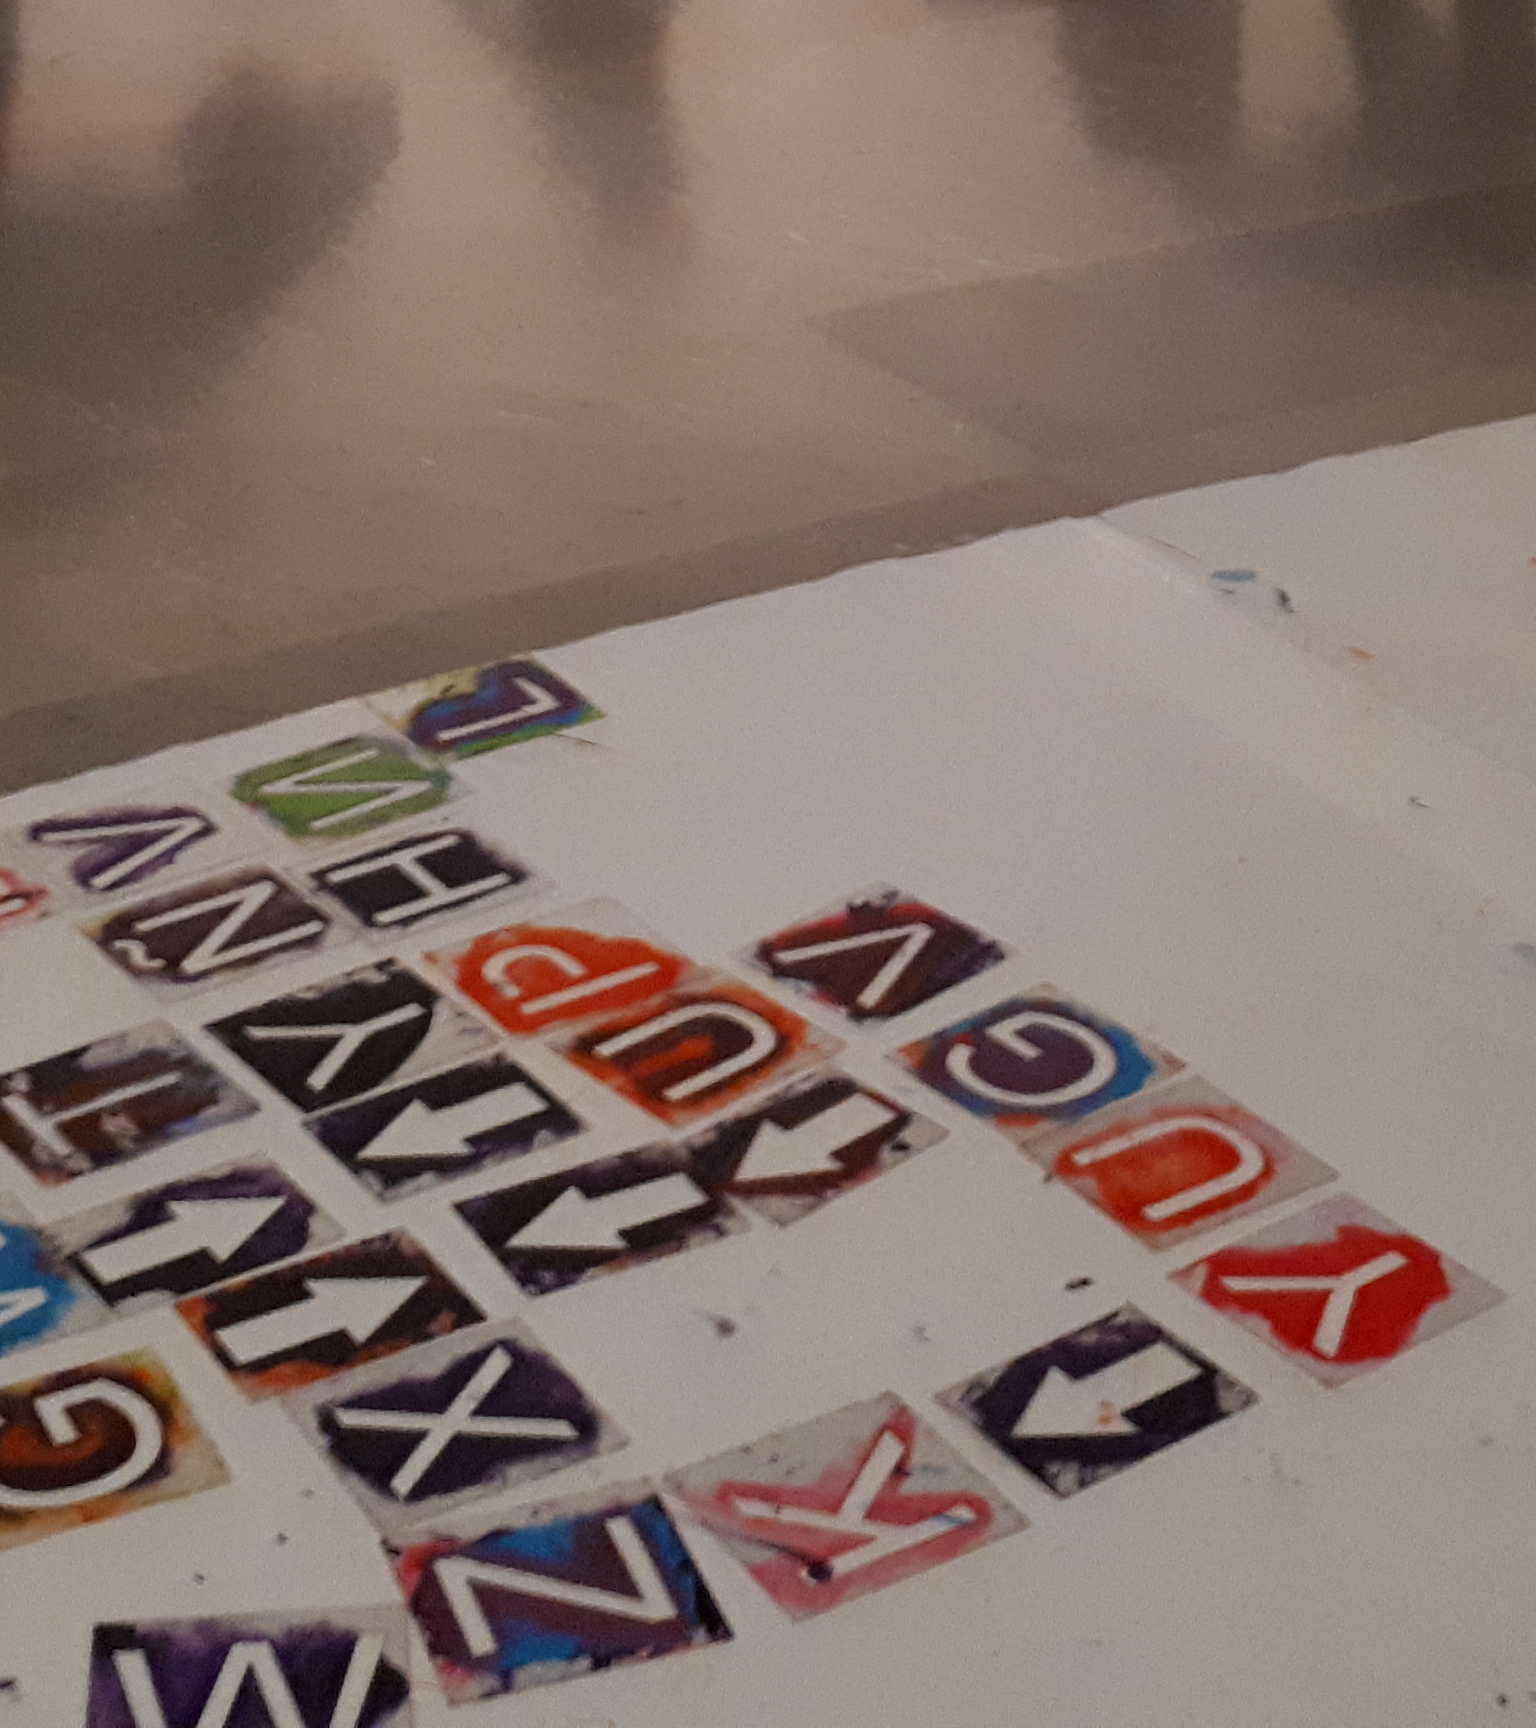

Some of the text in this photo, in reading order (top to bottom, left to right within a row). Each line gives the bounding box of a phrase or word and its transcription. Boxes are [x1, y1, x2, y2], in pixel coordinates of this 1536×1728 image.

[944, 1012, 1118, 1108] G
[1219, 1252, 1408, 1357] Y
[329, 1344, 581, 1502] X
[731, 1428, 978, 1584] K
